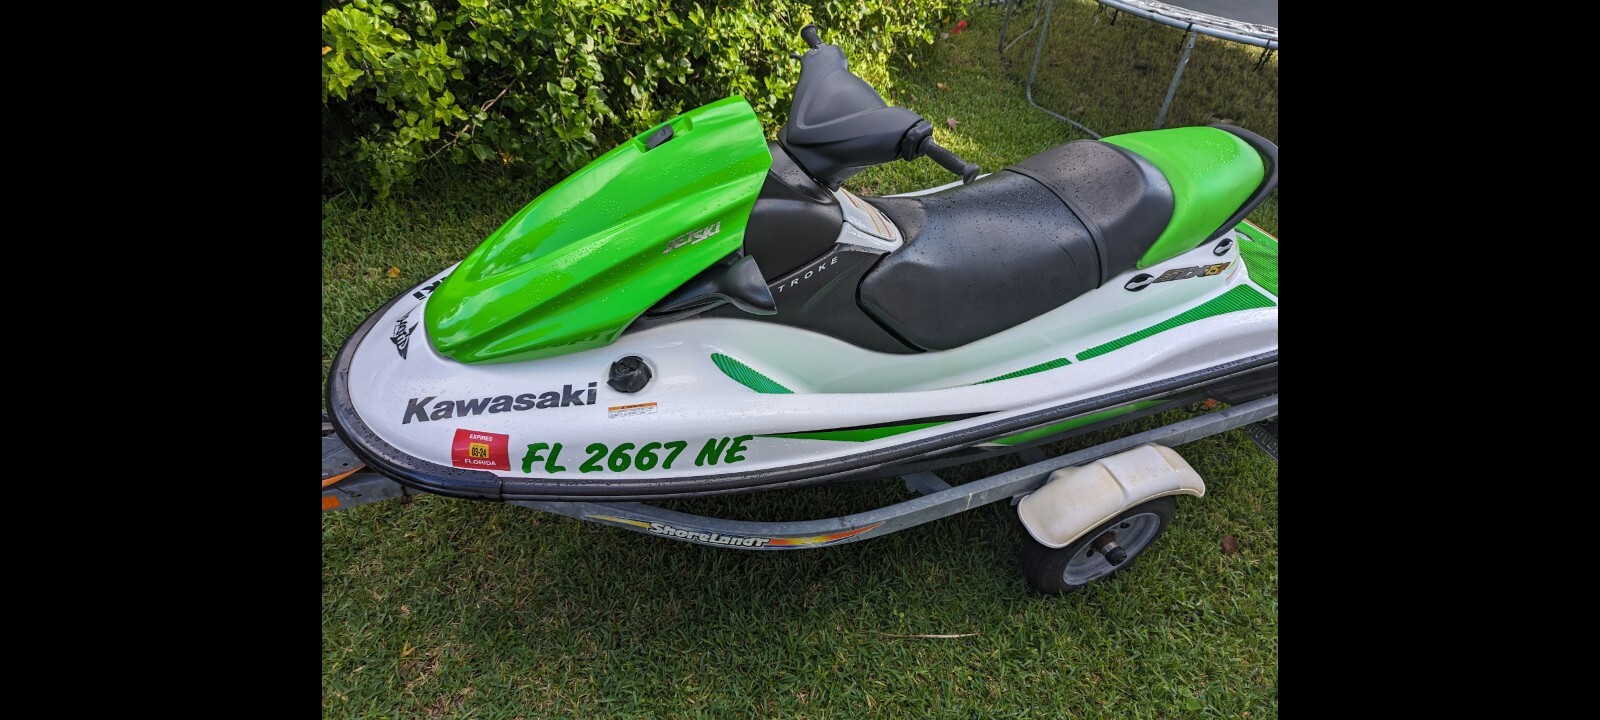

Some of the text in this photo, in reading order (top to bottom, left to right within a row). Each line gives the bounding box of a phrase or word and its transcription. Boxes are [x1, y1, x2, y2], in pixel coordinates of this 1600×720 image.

[402, 381, 598, 425] Kawasaki
[469, 433, 494, 442] EXPIRES
[471, 446, 487, 457] 03-24
[521, 434, 754, 474] FL 2667 NE
[464, 458, 496, 466] FLORIDA
